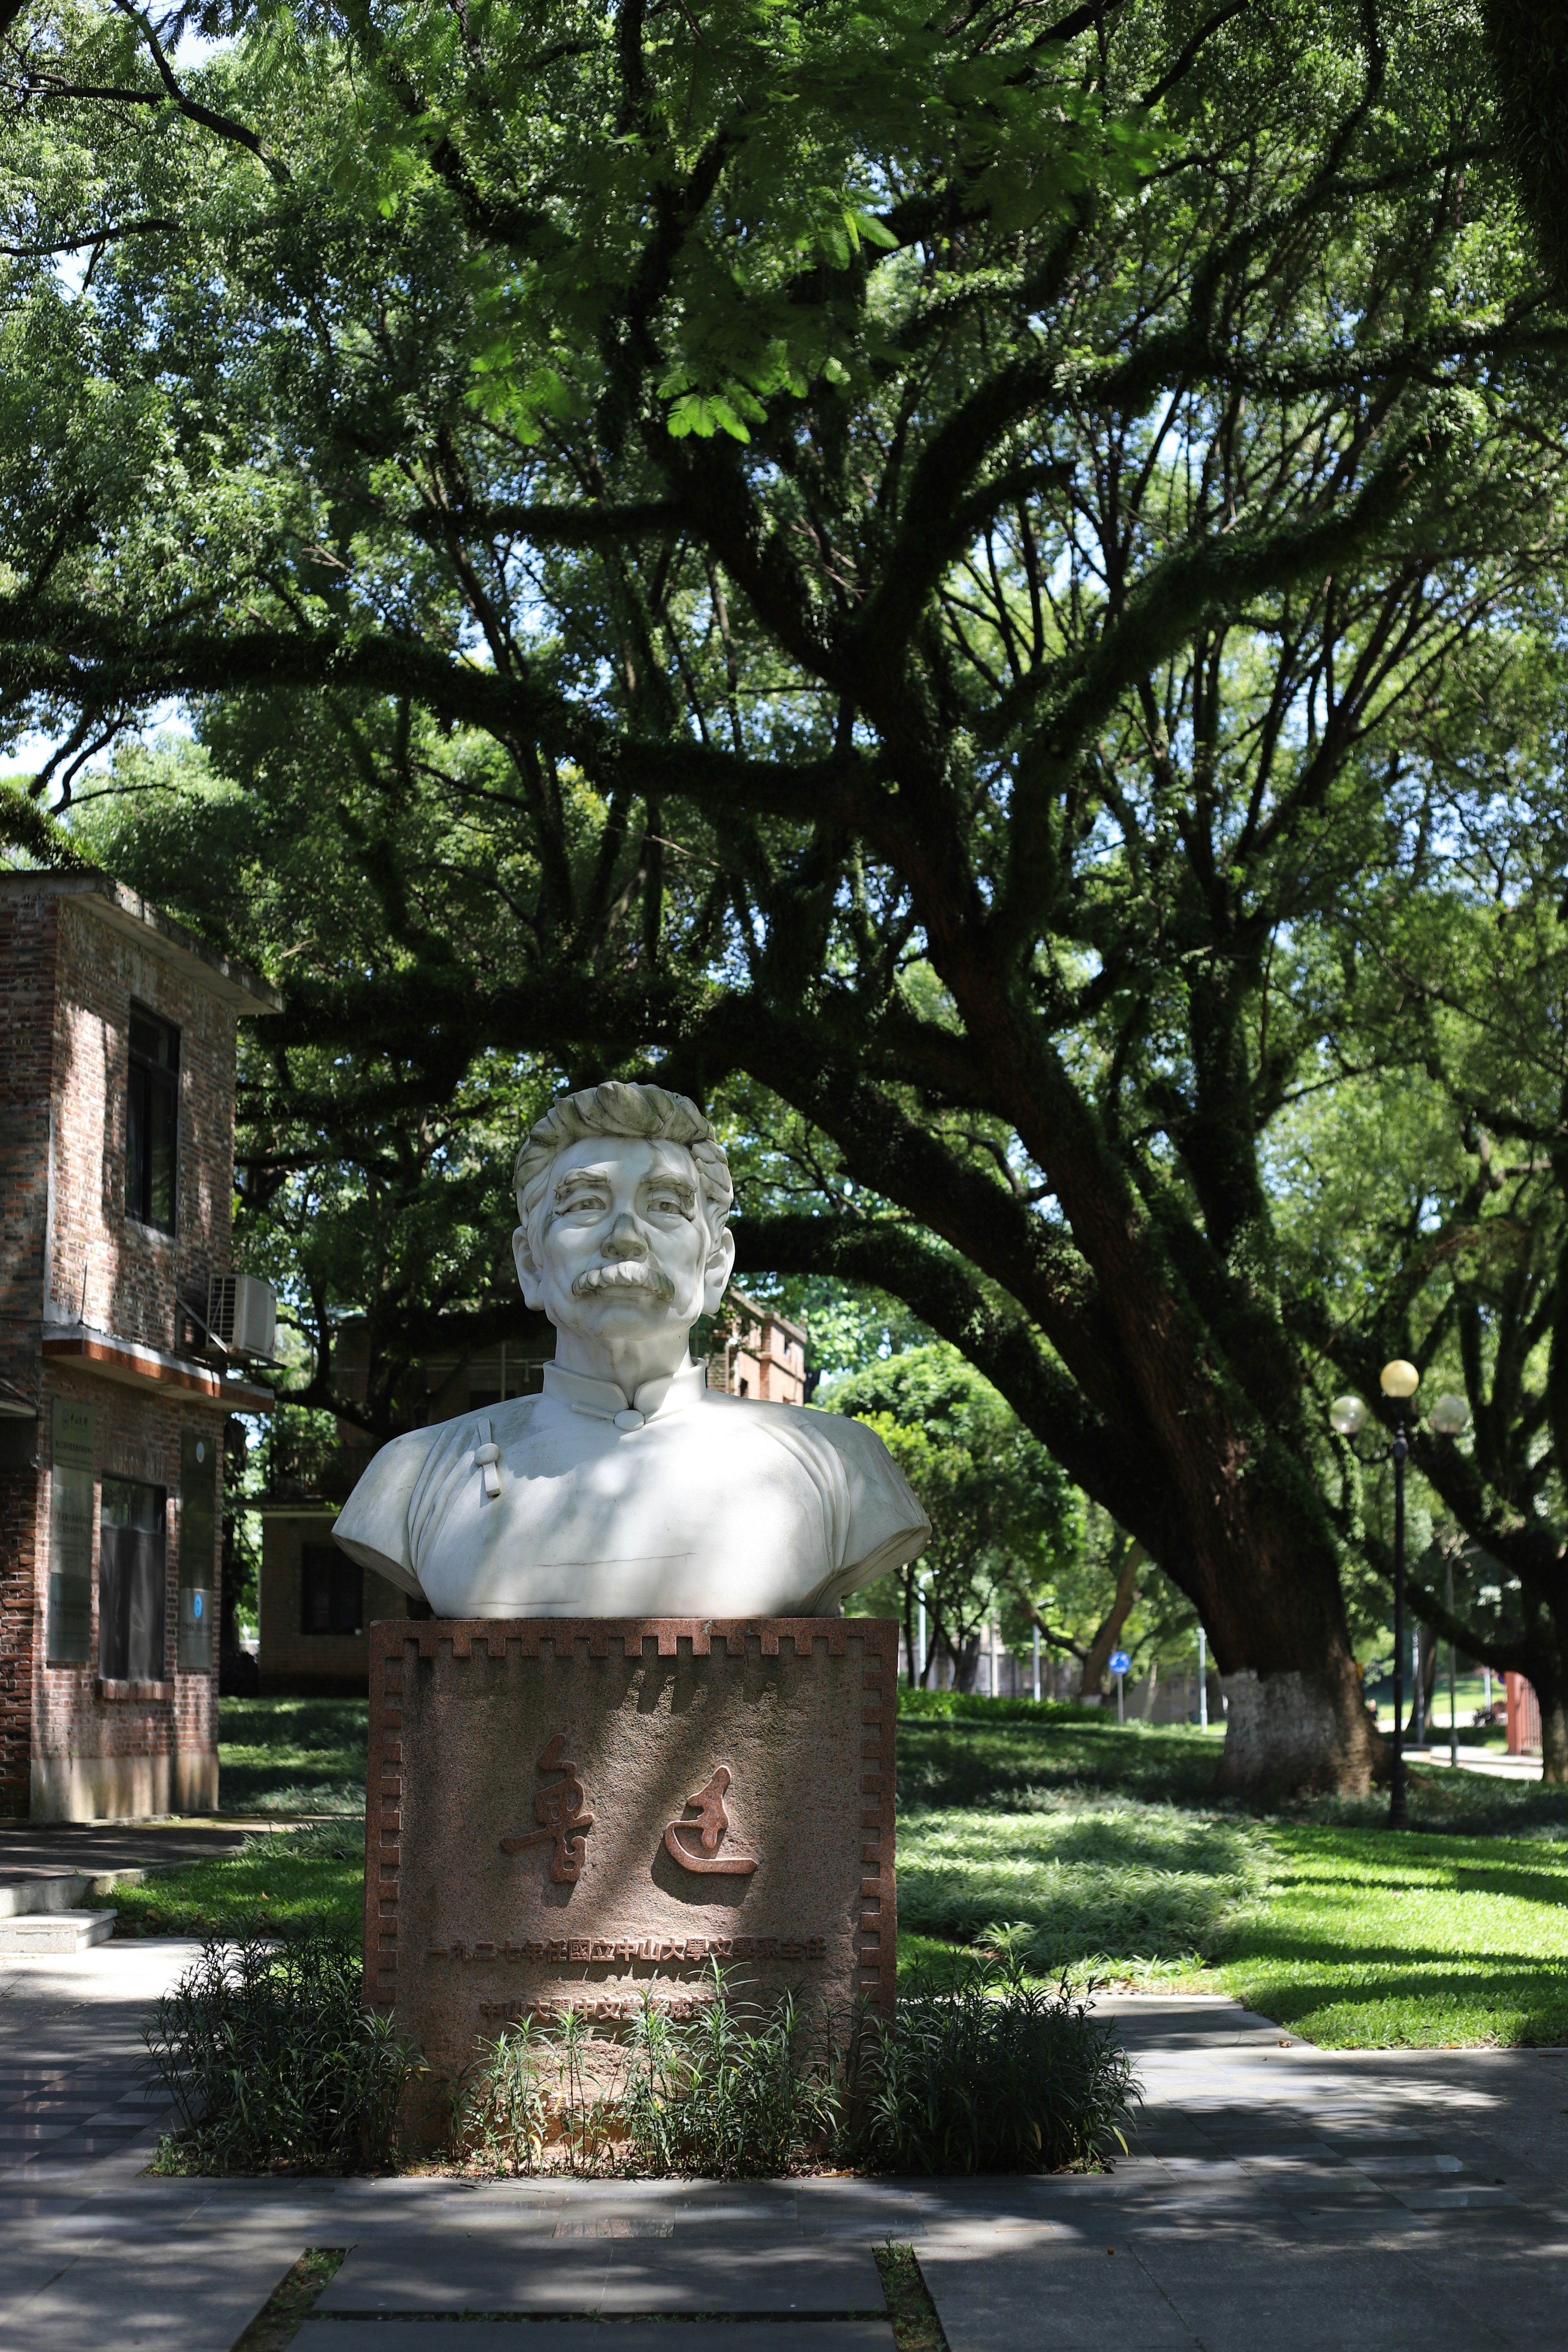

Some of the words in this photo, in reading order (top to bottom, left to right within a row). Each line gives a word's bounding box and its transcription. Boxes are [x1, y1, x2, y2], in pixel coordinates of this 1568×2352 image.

[426, 1936, 827, 1962] 一九二七年任國立中山大學文學系主任
